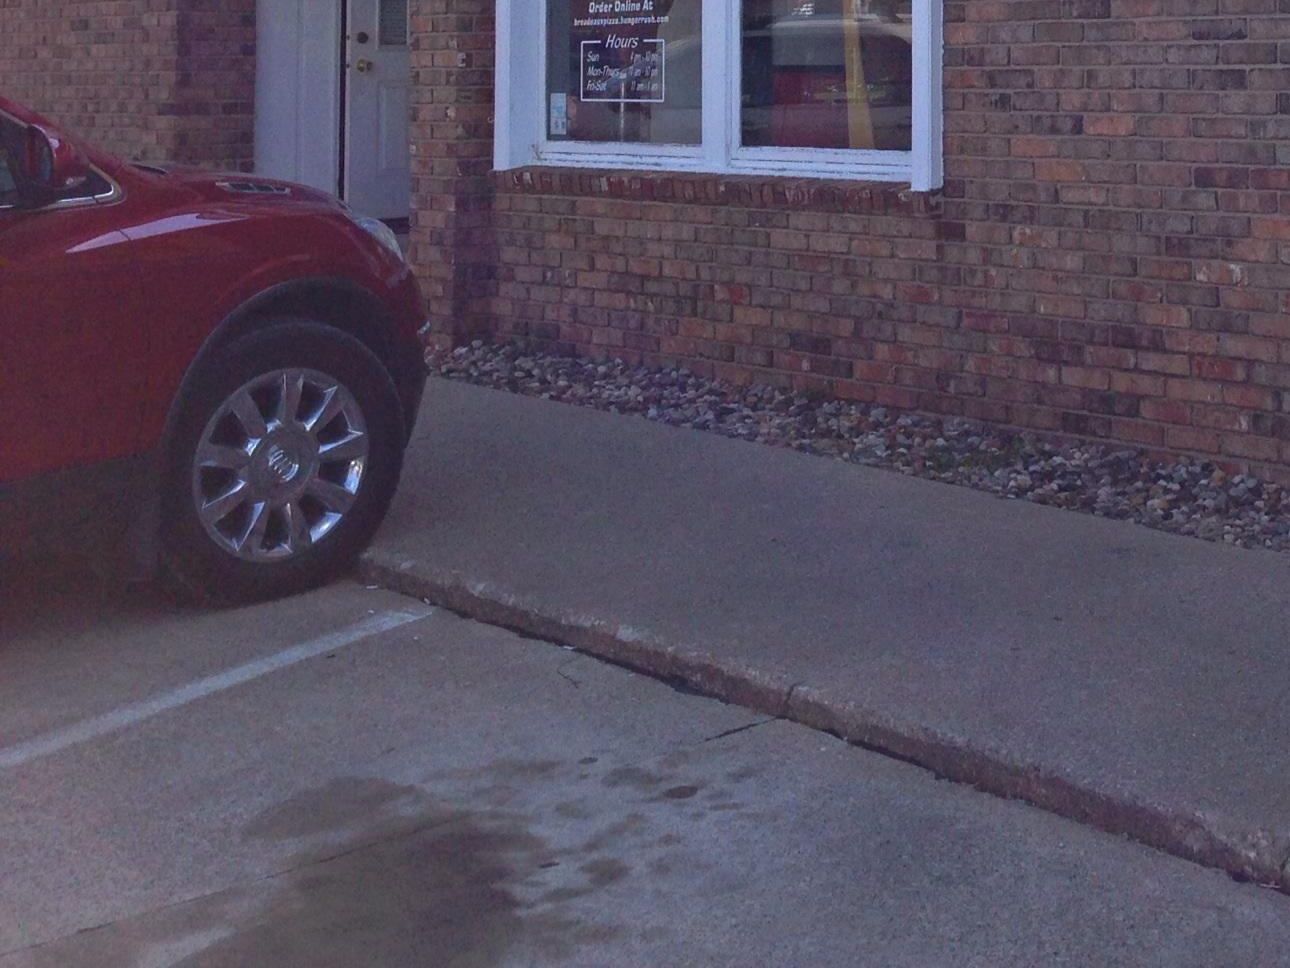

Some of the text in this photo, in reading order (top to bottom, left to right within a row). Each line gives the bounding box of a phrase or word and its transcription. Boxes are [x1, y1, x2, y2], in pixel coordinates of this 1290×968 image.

[589, 0, 653, 13] Order Online At
[605, 34, 639, 48] Hours
[586, 51, 600, 62] Sun
